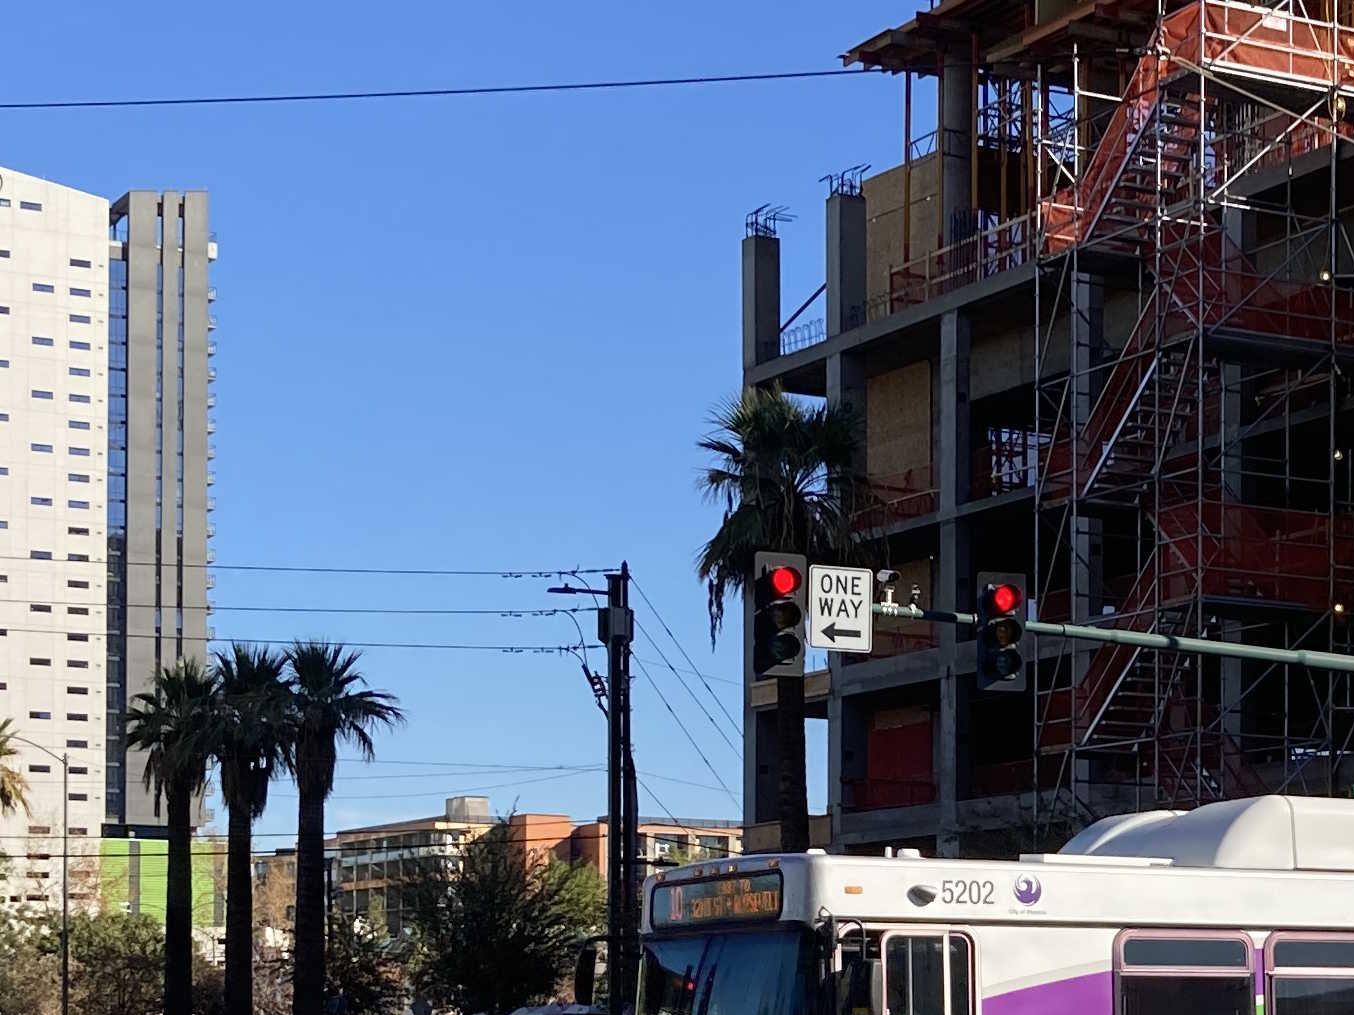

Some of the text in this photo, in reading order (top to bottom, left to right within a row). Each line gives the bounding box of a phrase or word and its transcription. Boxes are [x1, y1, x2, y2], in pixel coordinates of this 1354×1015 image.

[821, 574, 862, 595] ONE
[819, 597, 863, 618] WAY
[942, 880, 994, 904] 5202
